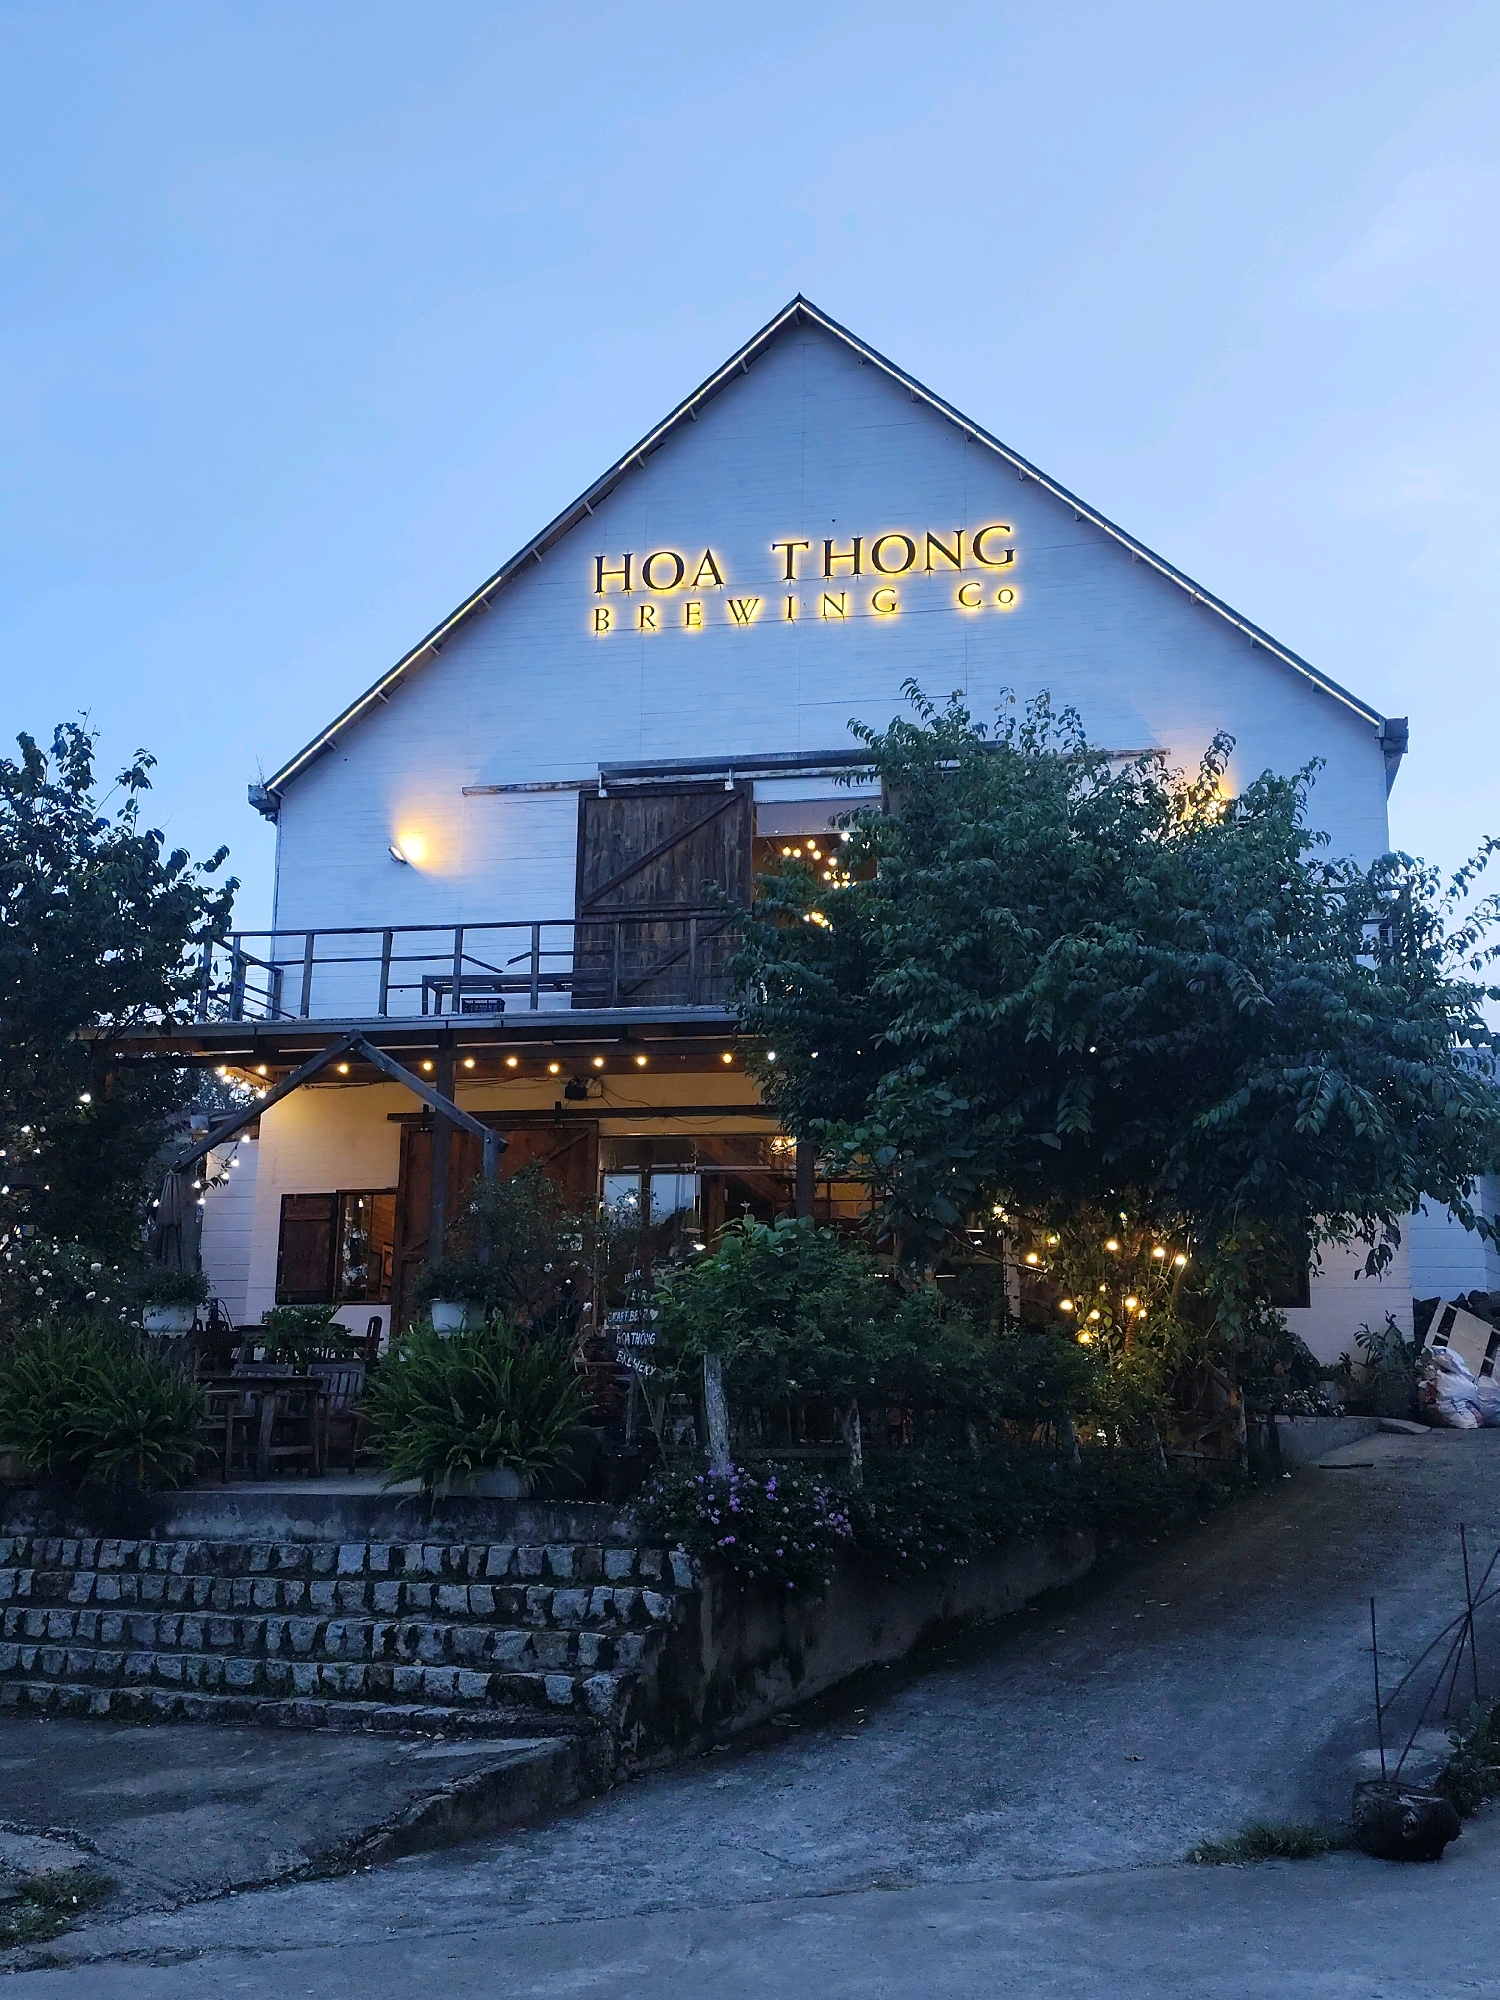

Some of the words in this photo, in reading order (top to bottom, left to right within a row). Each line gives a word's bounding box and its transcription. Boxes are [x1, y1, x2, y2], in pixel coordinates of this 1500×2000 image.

[594, 548, 725, 594] HOA
[772, 525, 1015, 581] THONG
[594, 588, 897, 632] BREWING
[957, 582, 1014, 608] Co
